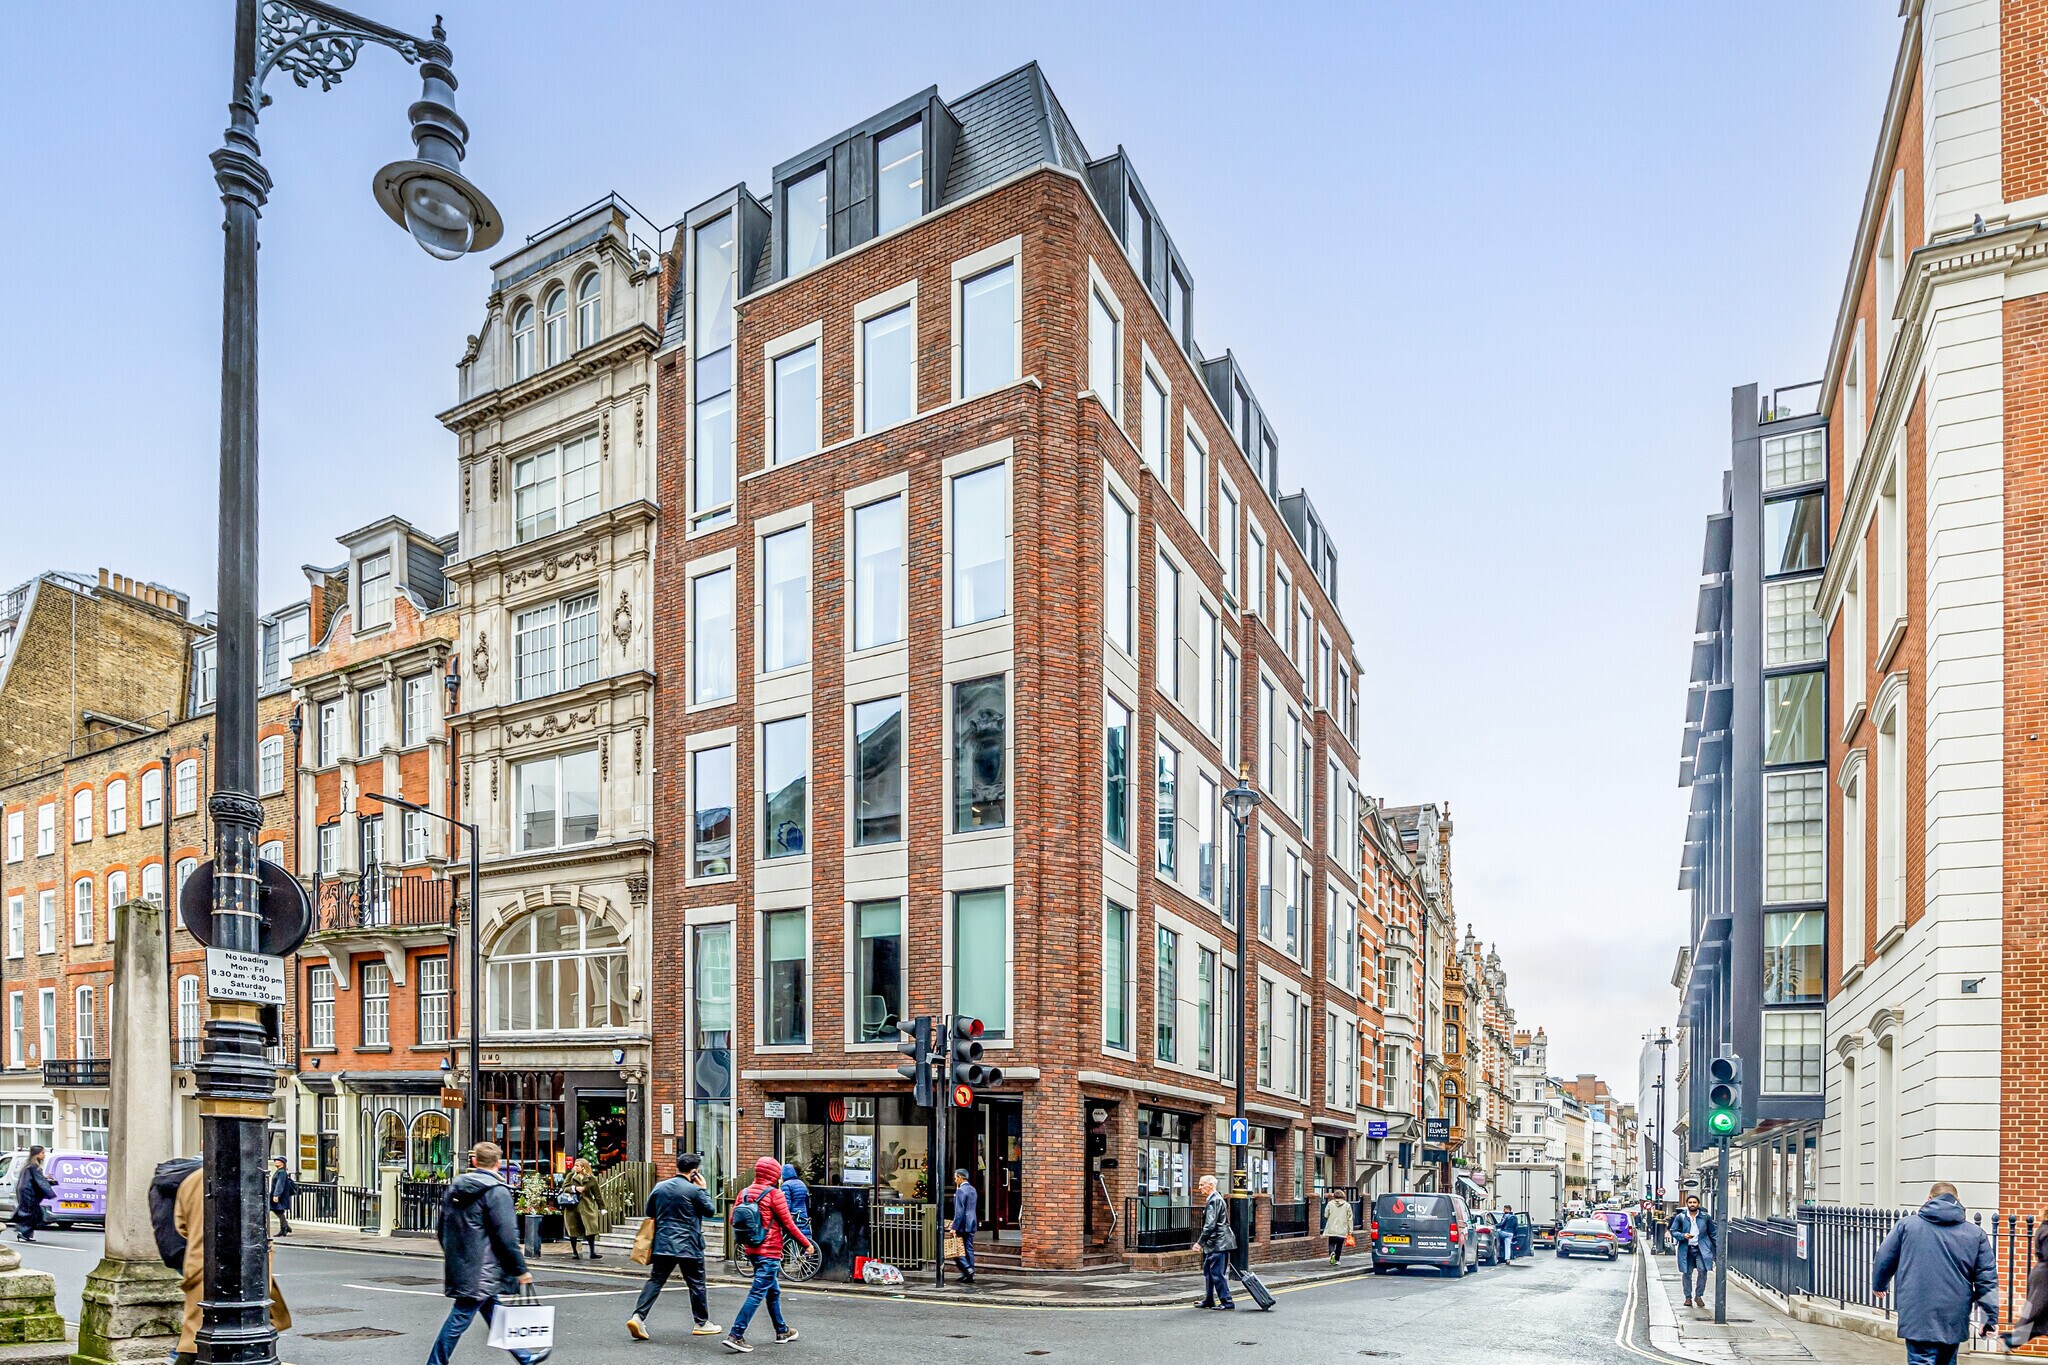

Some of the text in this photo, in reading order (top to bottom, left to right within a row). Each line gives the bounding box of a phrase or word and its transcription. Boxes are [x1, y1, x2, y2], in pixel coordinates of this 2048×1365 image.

[240, 955, 269, 966] loading
[231, 963, 248, 971] Mon
[211, 969, 231, 977] 8.30
[251, 974, 270, 982] 6.30
[213, 987, 233, 995] 8.30
[230, 981, 267, 991] Saturday
[179, 1077, 187, 1088] 10
[279, 1076, 288, 1089] 10
[626, 1088, 638, 1103] 12
[848, 1101, 874, 1118] JLL
[900, 1158, 922, 1170] JLL
[1406, 1204, 1428, 1214] City
[507, 1326, 549, 1337] HOFF
